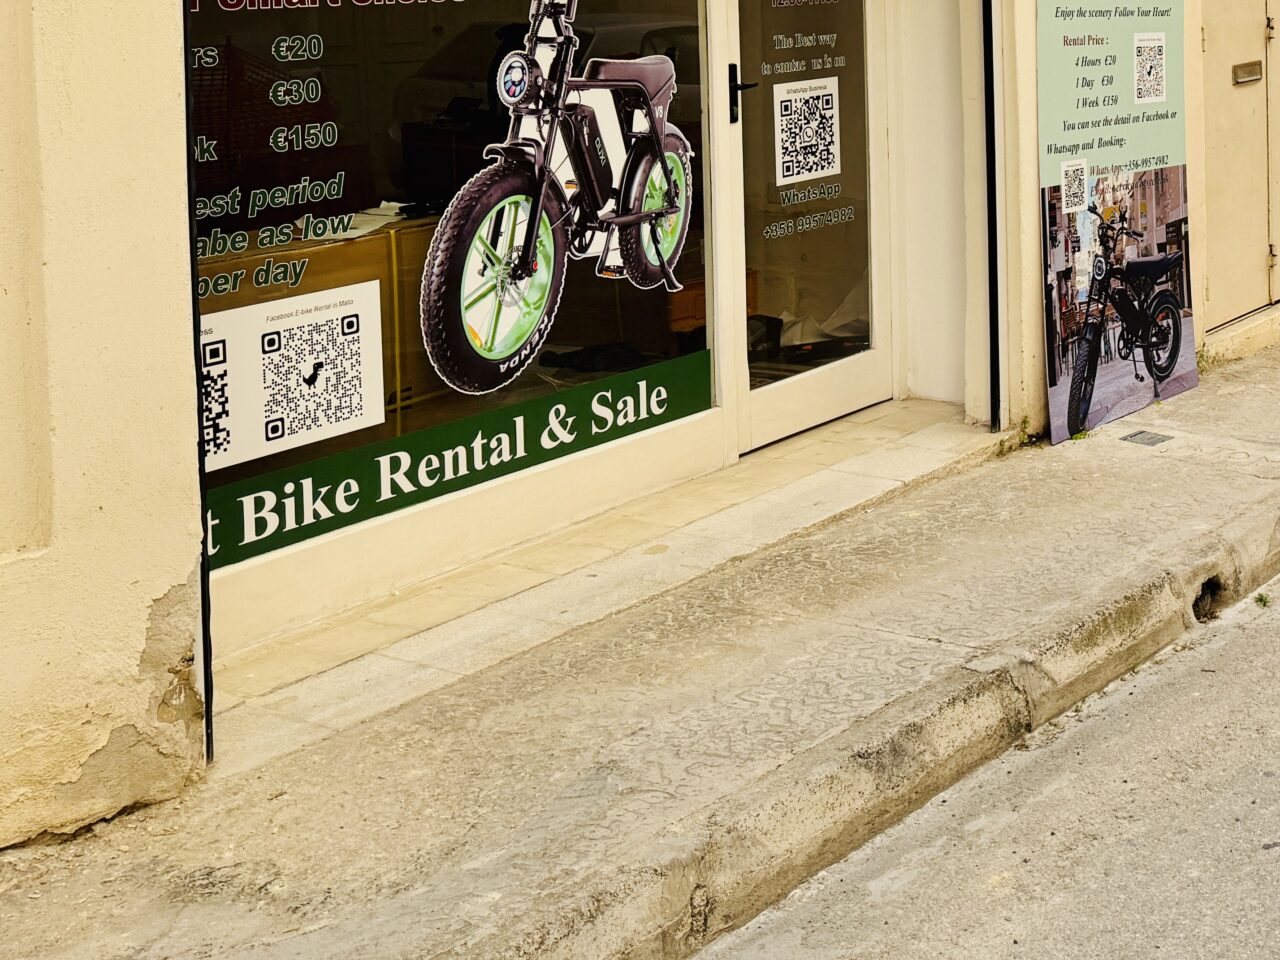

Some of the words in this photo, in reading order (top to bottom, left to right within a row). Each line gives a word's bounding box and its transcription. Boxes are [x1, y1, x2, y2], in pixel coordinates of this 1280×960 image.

[1055, 7, 1075, 21] Enjoy
[1076, 7, 1087, 18] the
[1088, 9, 1112, 20] scenery
[1114, 7, 1135, 17] Follow
[1137, 7, 1151, 17] Your
[1152, 7, 1172, 17] Heart!
[271, 34, 324, 62] €20
[773, 34, 794, 49] The
[794, 33, 817, 48] Best
[818, 33, 837, 48] way
[1063, 35, 1086, 46] Rental
[761, 61, 772, 75] to
[811, 58, 822, 70] us
[824, 53, 832, 69] is
[834, 55, 846, 67] on
[1081, 56, 1101, 67] Hours
[1104, 54, 1117, 66] €20
[269, 78, 321, 106] €30
[1081, 76, 1094, 90] Day
[1101, 75, 1114, 87] €30
[1082, 96, 1099, 108] Week
[1102, 94, 1118, 106] €150
[1063, 120, 1076, 131] You
[1077, 120, 1089, 130] can
[1091, 119, 1101, 128] see
[1102, 116, 1113, 127] the
[1114, 113, 1131, 125] detail
[1132, 114, 1140, 123] on
[1141, 110, 1169, 122] Facebook
[1170, 111, 1177, 119] or
[269, 121, 338, 152] €150
[1047, 143, 1080, 156] Whatsapp
[1081, 138, 1094, 150] and
[1097, 136, 1127, 149] Booking:
[248, 171, 345, 218] period
[780, 183, 841, 207] WhatsApp
[258, 223, 294, 248] as
[302, 213, 355, 241] low
[763, 219, 794, 238] +356
[797, 206, 855, 233] 99574982
[253, 258, 308, 288] day
[237, 477, 360, 546] Bike
[374, 416, 528, 504] Rental
[540, 404, 577, 450] &
[591, 380, 669, 435] Sale
